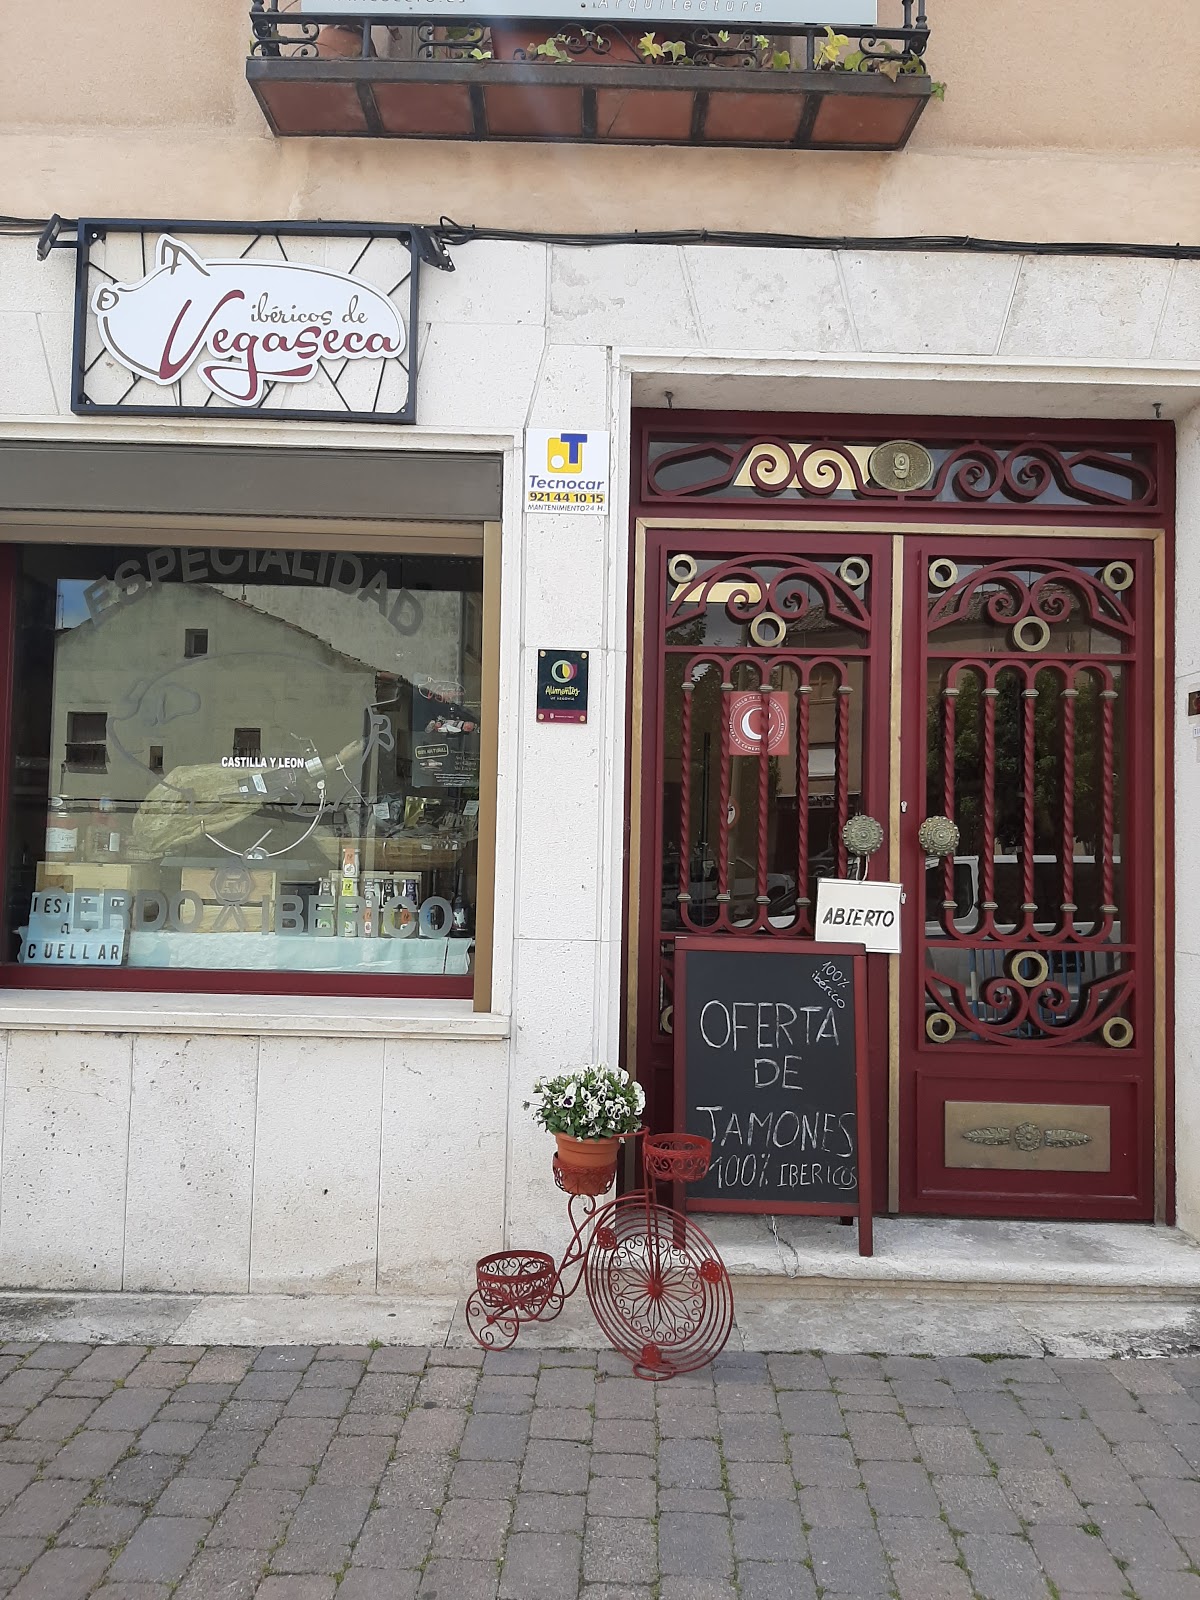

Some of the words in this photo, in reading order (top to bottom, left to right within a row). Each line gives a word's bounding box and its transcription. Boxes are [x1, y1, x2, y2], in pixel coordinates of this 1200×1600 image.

[250, 292, 332, 325] ibéricos
[341, 294, 368, 324] de
[158, 289, 401, 400] Vegaseca
[894, 452, 910, 479] 9
[528, 475, 604, 490] Tecnocar
[529, 492, 551, 502] 921
[553, 493, 570, 502] 44
[573, 493, 587, 503] 10
[590, 494, 604, 503] 15
[82, 547, 424, 637] ESPECIALIDAD
[221, 757, 268, 768] CASTILLA
[270, 757, 277, 768] Y
[278, 757, 304, 769] LEON
[38, 886, 203, 934] CERDO
[262, 894, 453, 938] IBERICO
[822, 907, 895, 928] ABIERTO
[27, 943, 119, 960] CUELLAR
[820, 961, 850, 988] 100%
[700, 1000, 840, 1050] OFERTA
[754, 1055, 803, 1090] DE
[708, 1153, 770, 1188] 100%
[777, 1162, 858, 1190] IBERICOS
